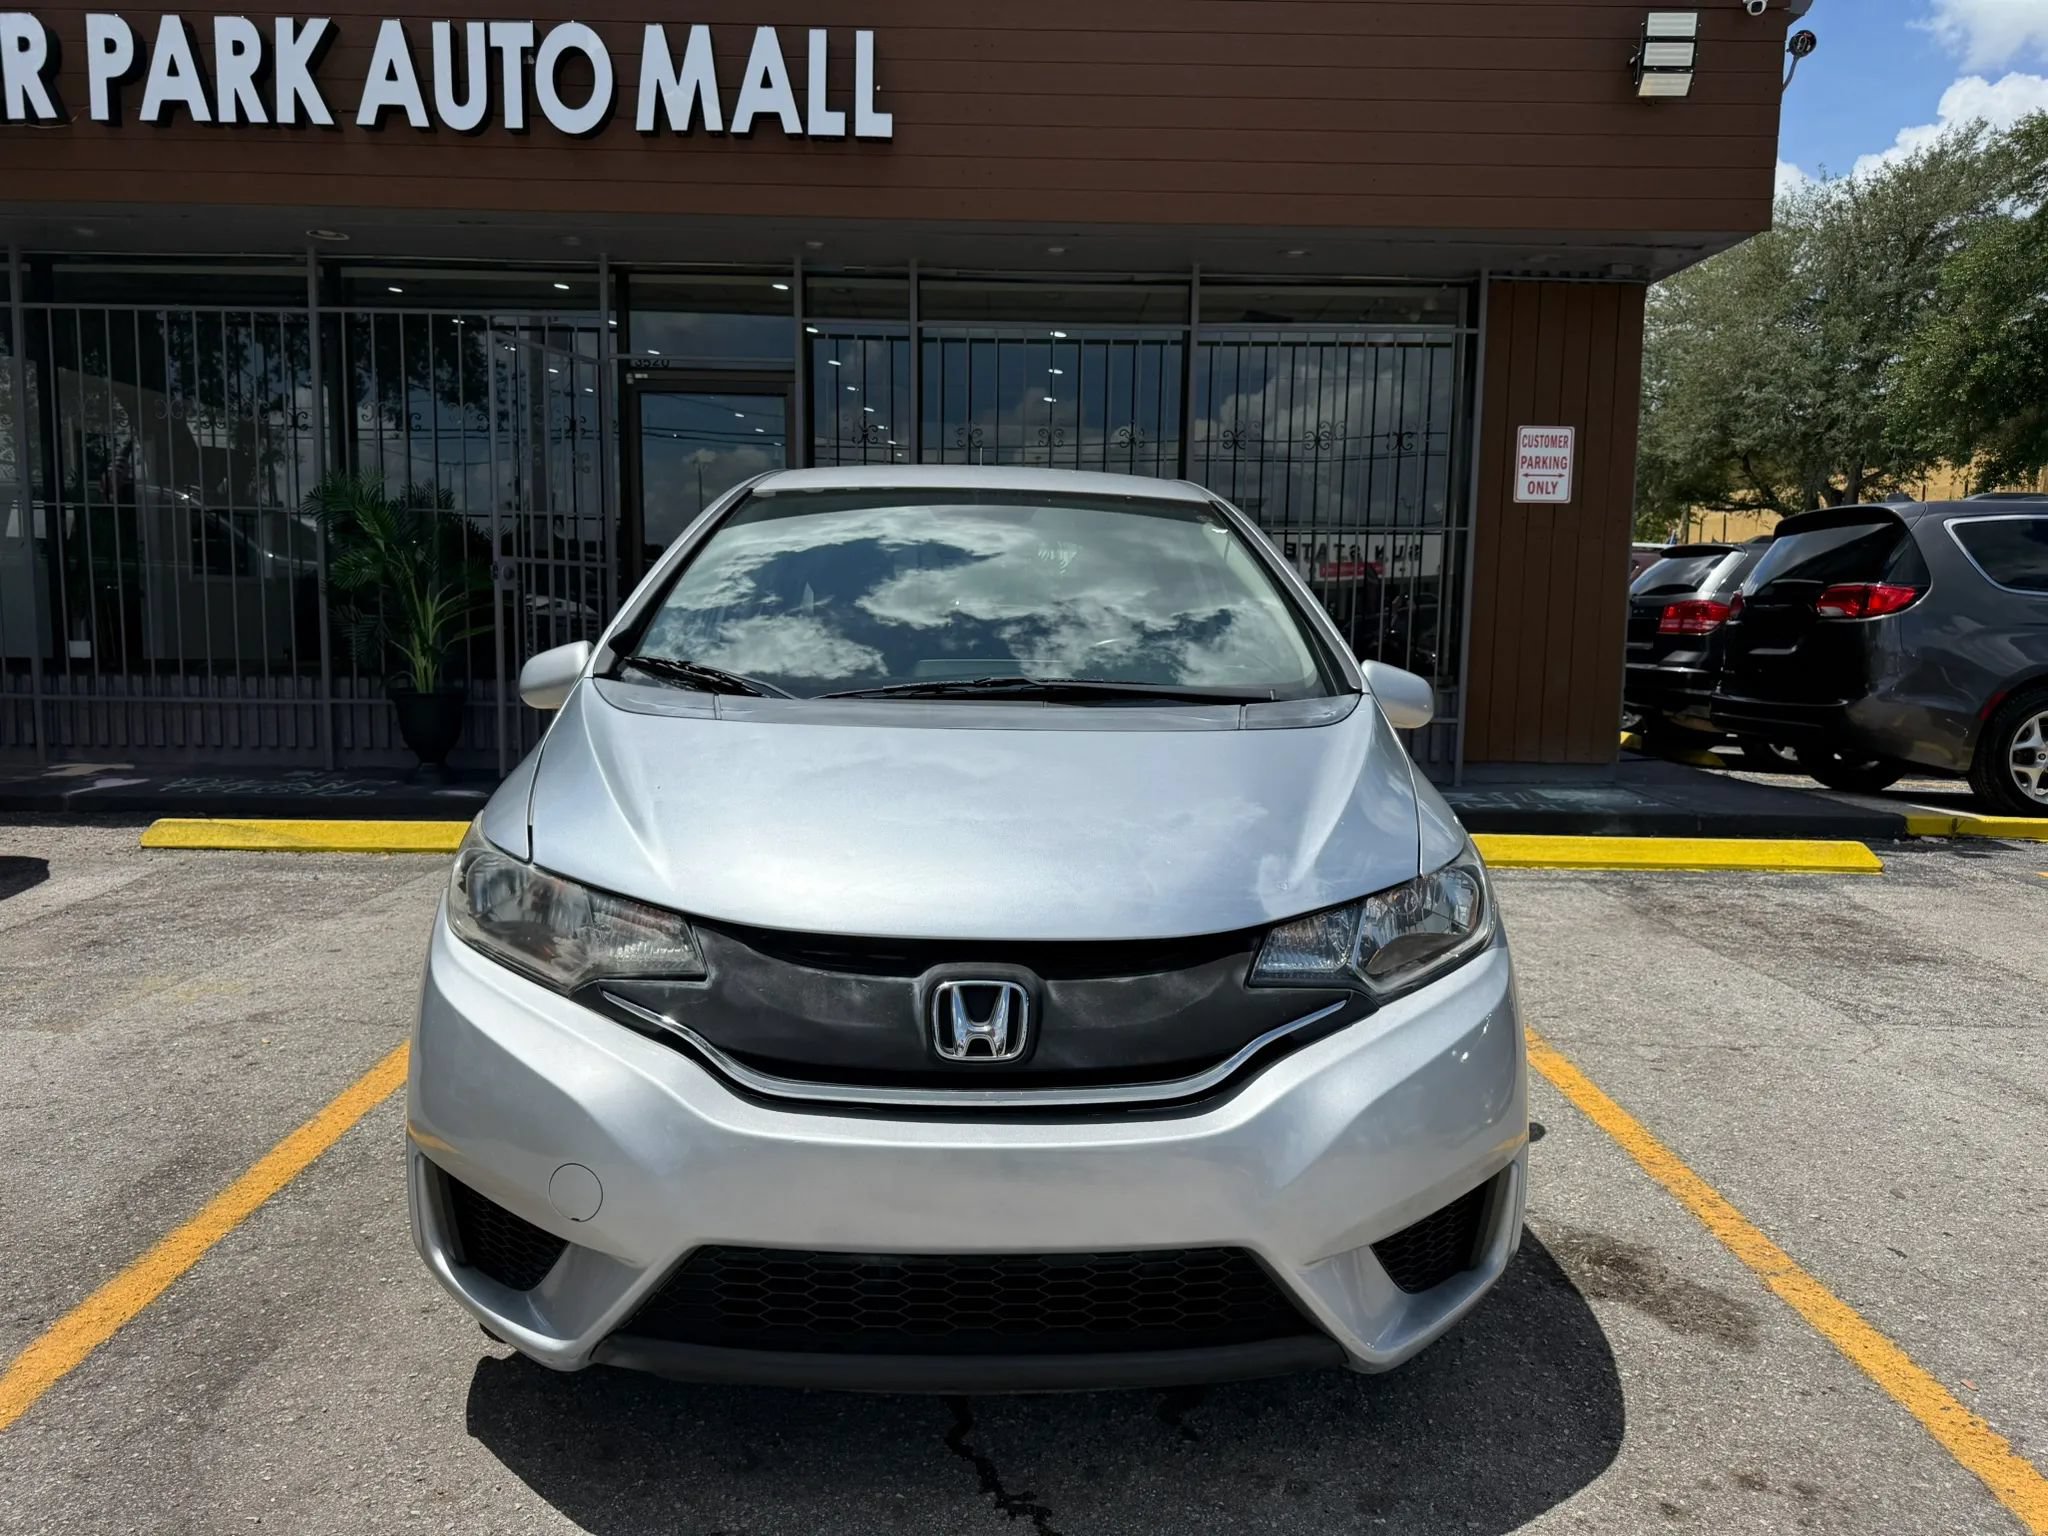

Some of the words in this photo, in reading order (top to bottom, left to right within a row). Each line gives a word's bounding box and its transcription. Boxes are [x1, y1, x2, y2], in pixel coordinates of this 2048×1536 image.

[0, 12, 58, 120] R
[86, 13, 334, 126] PARK
[356, 18, 613, 135] AUTO
[635, 24, 893, 138] MALL
[1521, 434, 1569, 449] CUSTOMER
[1520, 455, 1568, 470] PARKING
[1527, 480, 1559, 495] ONLY
